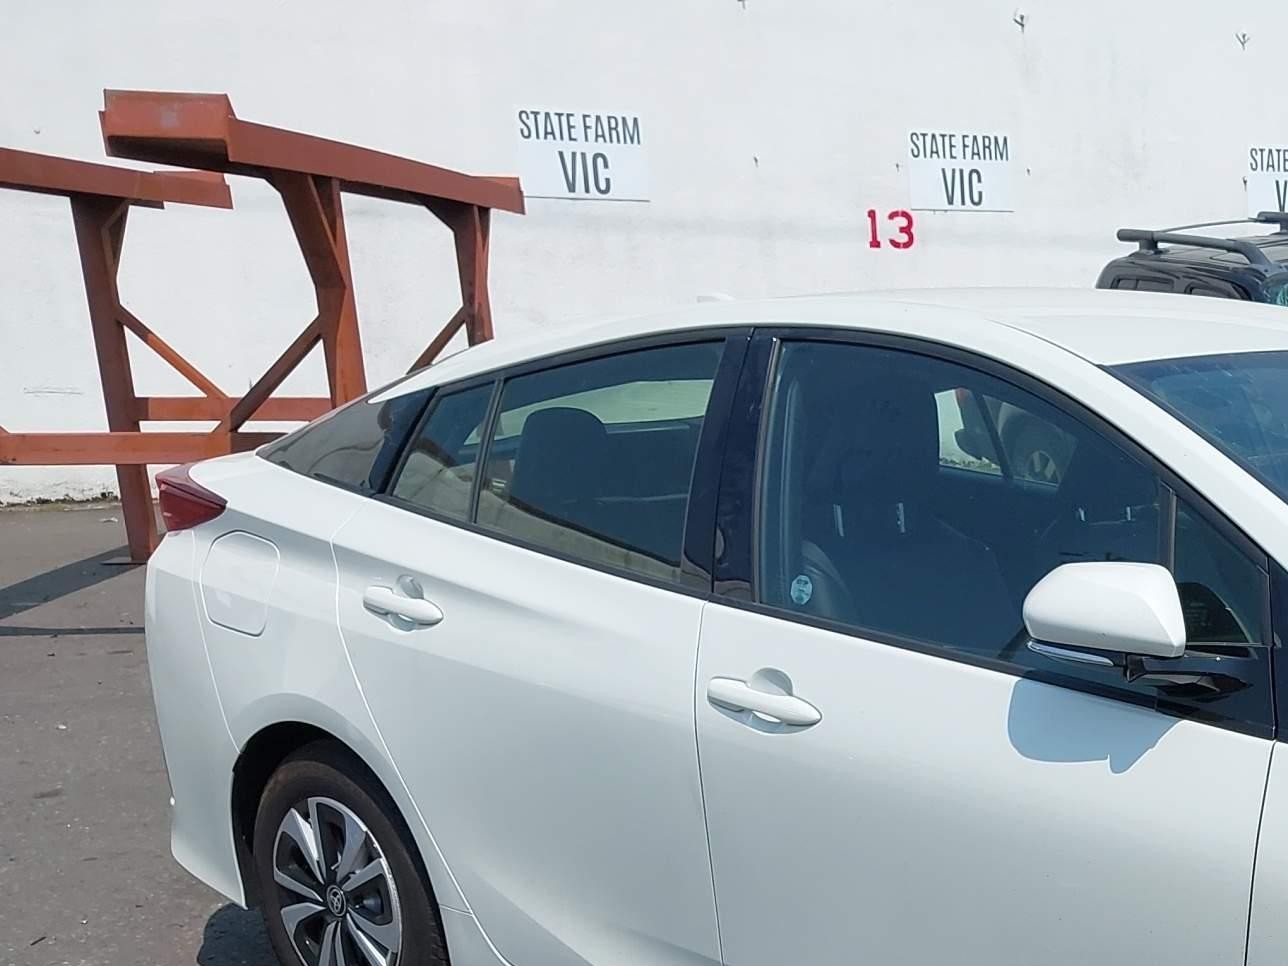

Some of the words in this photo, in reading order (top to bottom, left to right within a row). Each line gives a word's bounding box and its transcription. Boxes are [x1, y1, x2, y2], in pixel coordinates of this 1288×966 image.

[519, 110, 578, 143] STATE
[582, 114, 641, 146] FARM
[911, 132, 958, 160] STATE
[962, 135, 1010, 162] FARM
[558, 151, 611, 196] VIC
[942, 168, 984, 207] VIC
[867, 210, 916, 250] 13
